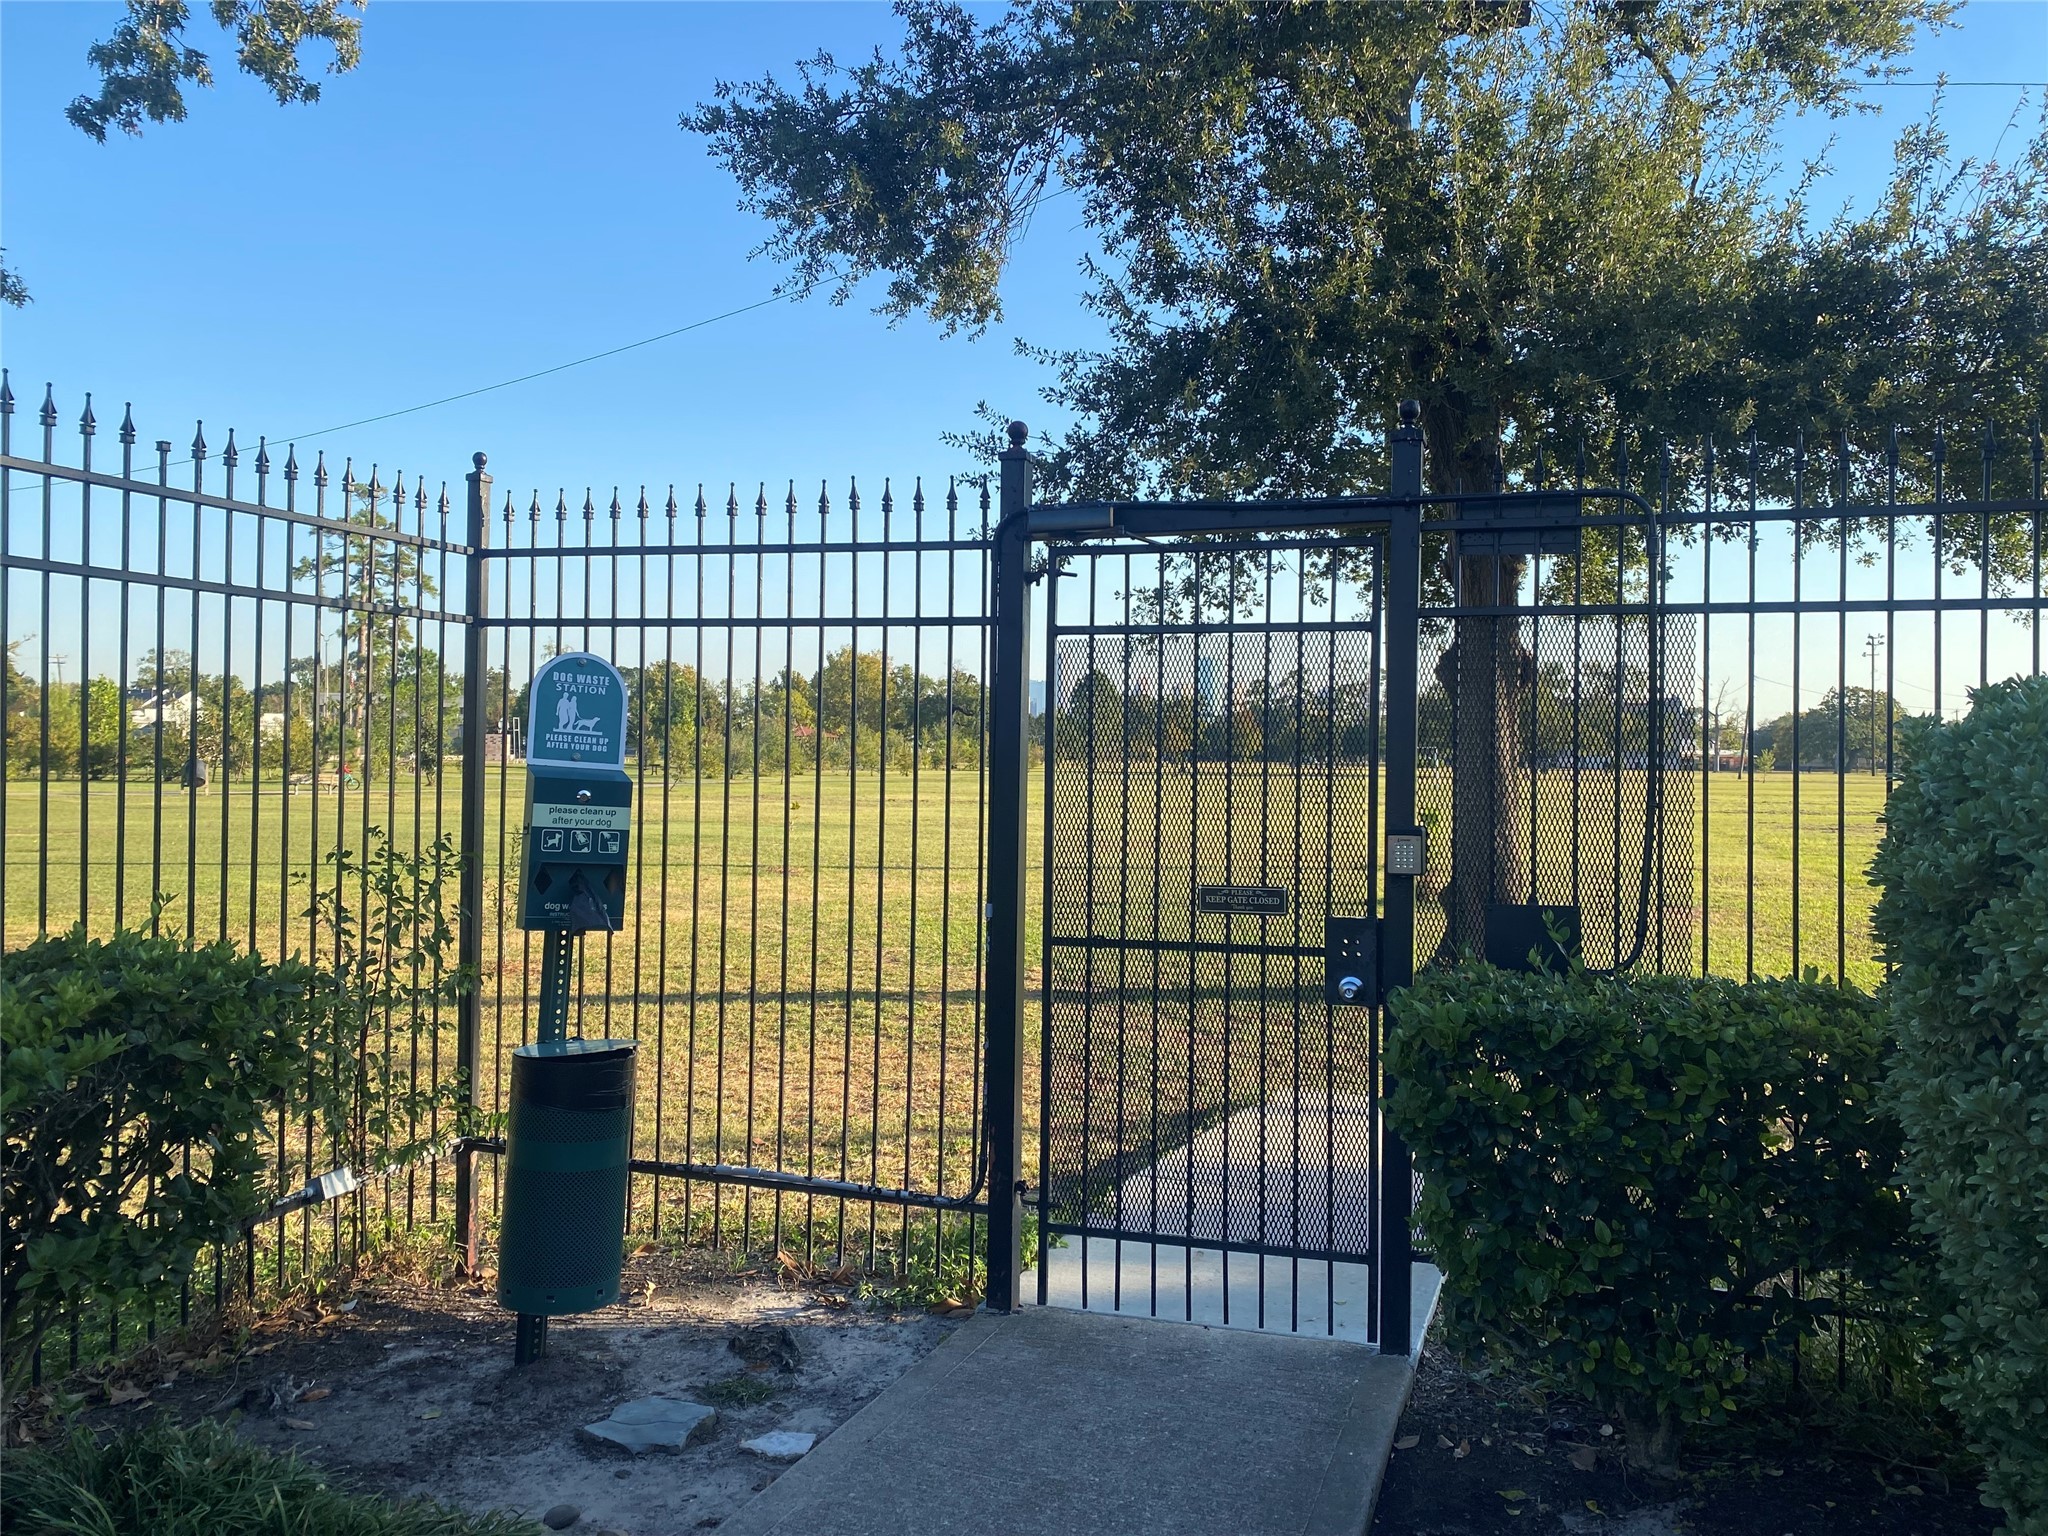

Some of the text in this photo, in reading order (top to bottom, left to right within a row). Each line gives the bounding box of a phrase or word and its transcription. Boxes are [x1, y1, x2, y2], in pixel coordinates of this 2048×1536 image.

[553, 671, 610, 686] DOG WASTE
[555, 683, 606, 695] STATION
[545, 733, 609, 745] PLEASE CLEAN UP
[546, 741, 569, 749] AFTER
[571, 743, 590, 751] YOUR
[549, 806, 617, 817] please clean up
[552, 816, 612, 828] after your dog
[1205, 895, 1280, 905] KEEP GATE CLOSED
[544, 901, 561, 911] dog
